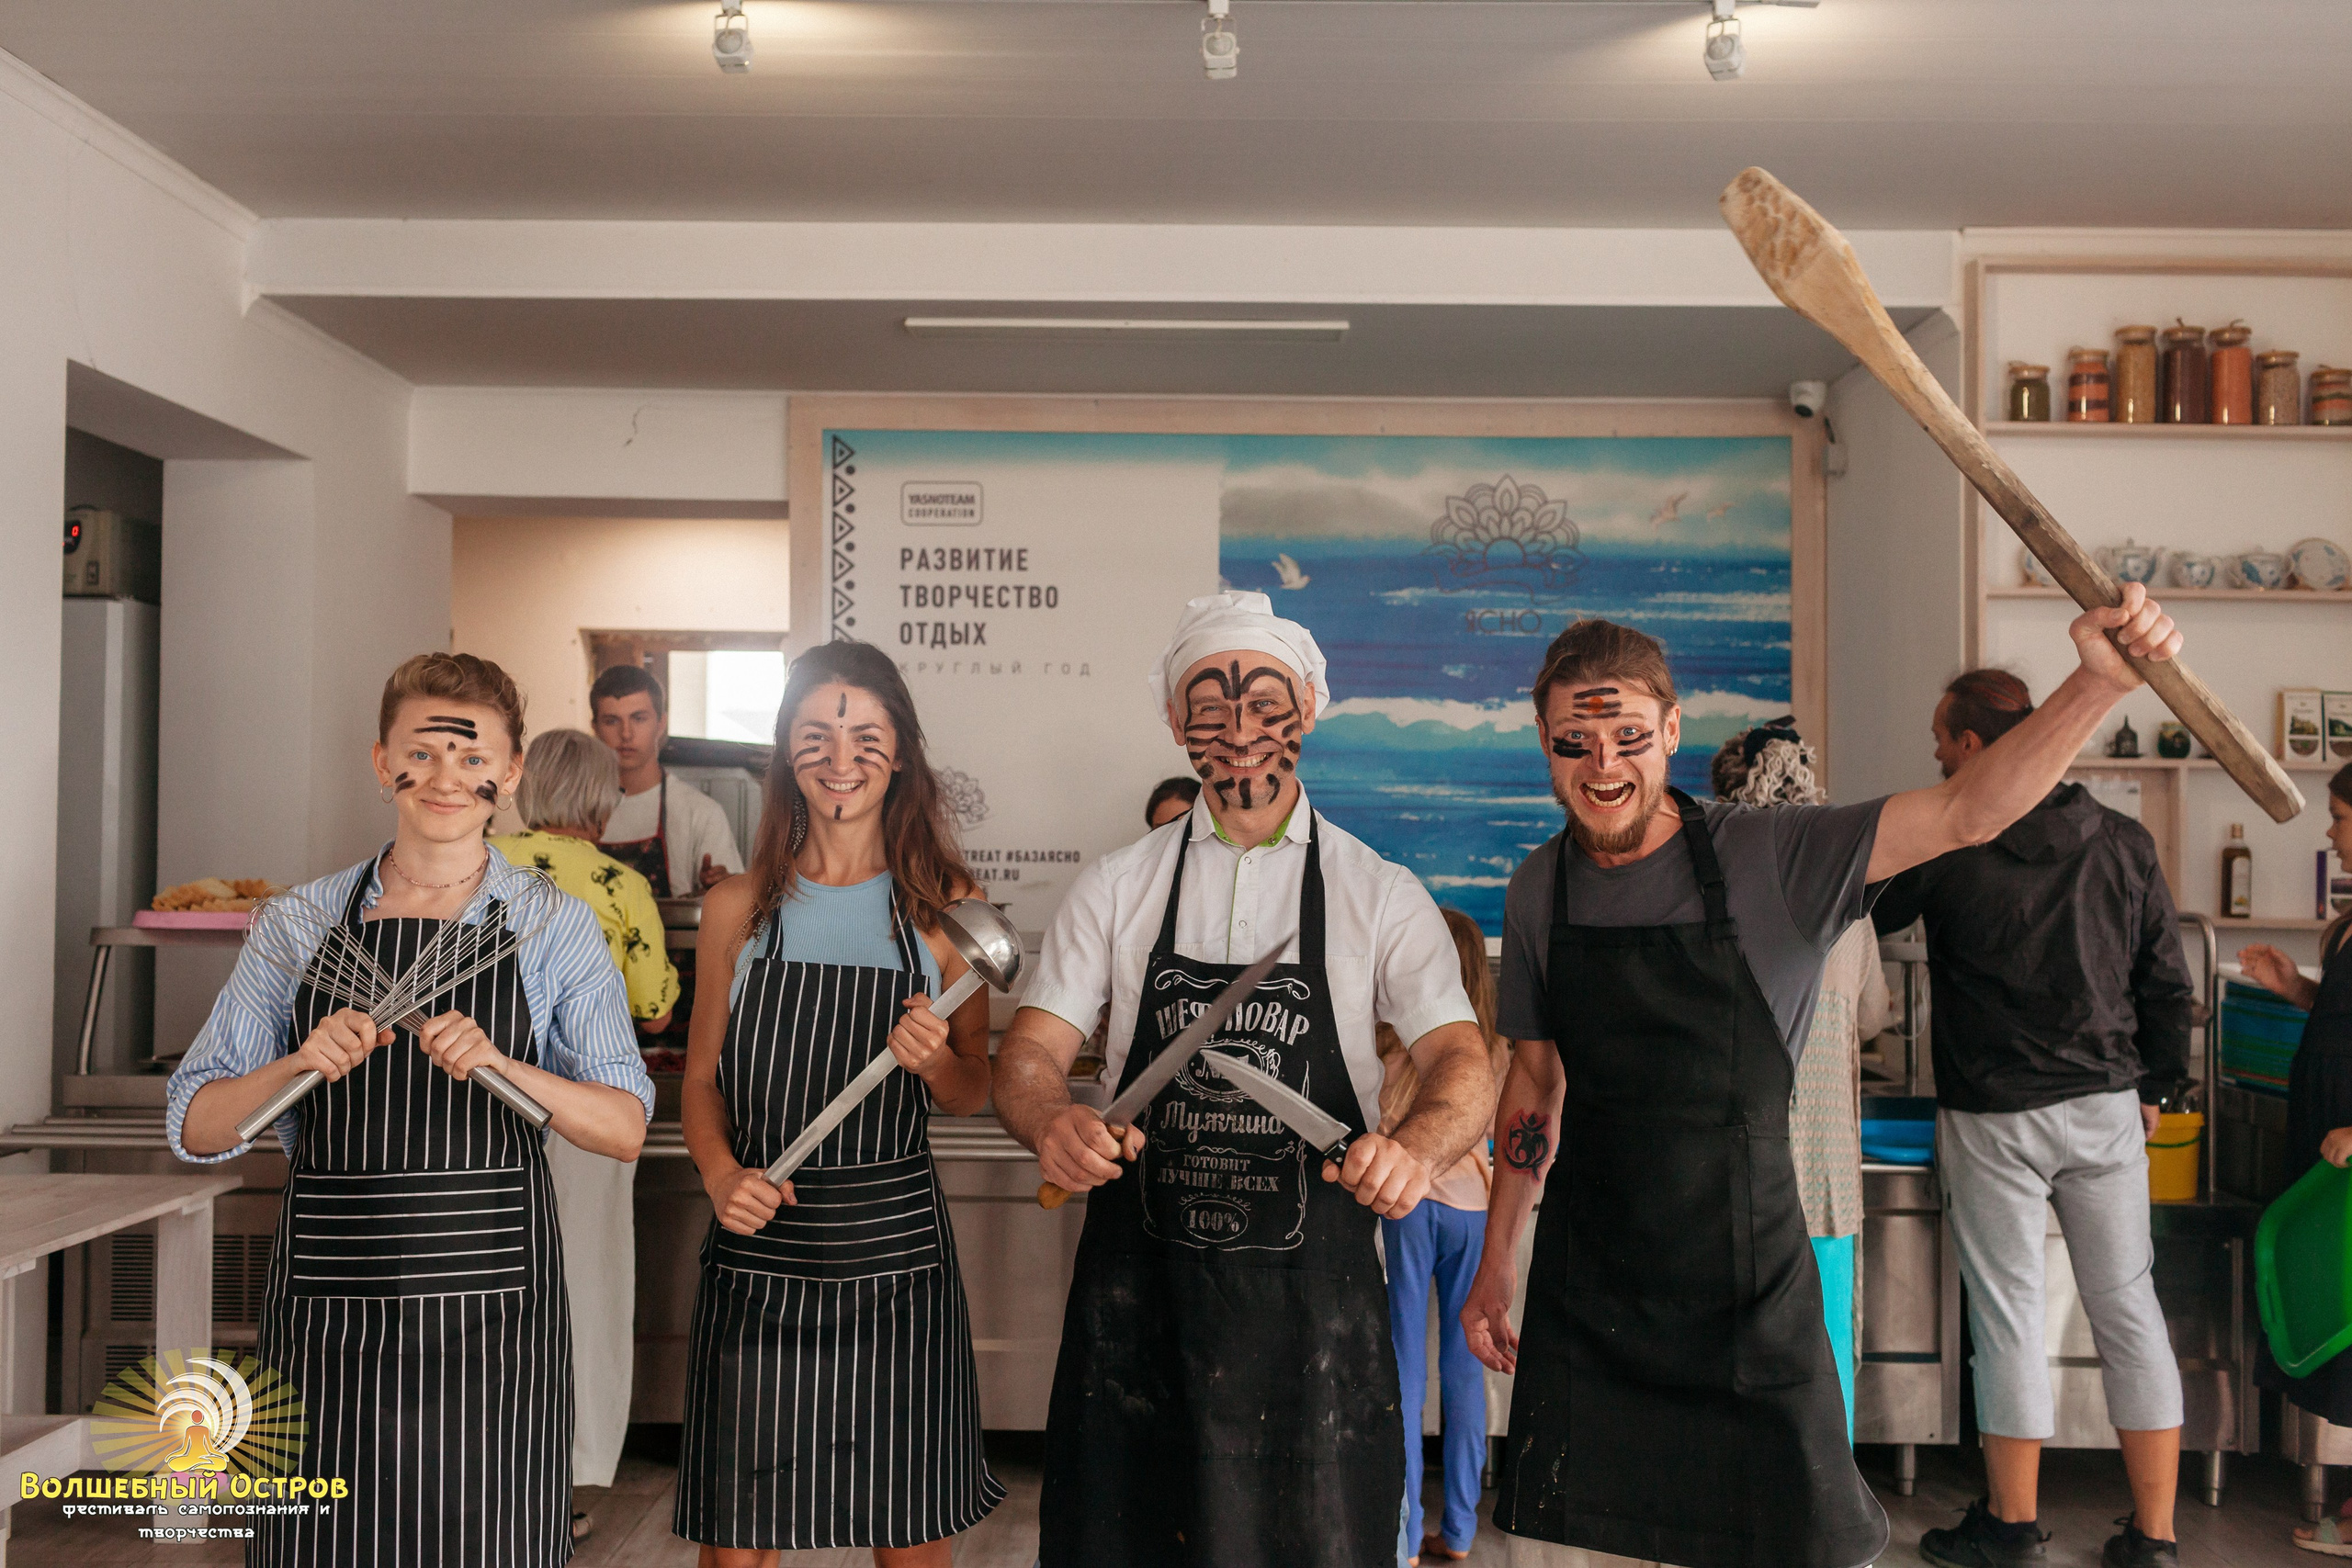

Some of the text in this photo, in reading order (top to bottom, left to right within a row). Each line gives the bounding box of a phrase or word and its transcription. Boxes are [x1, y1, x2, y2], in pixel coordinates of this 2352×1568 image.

[908, 507, 976, 518] COOPERATION
[899, 547, 1029, 571] РАЗВИТИЕ
[899, 584, 1059, 609] ТВОРЧЕСТВО
[899, 621, 988, 649] ОТДЫХ
[899, 660, 1091, 677] КРУГЛЫЙ ГОД
[1160, 1100, 1285, 1144] Мужчина
[1182, 1154, 1251, 1172] ГОТОВИТ
[1157, 1168, 1280, 1192] ЛУЧШЕ ВСЕХ
[1186, 1209, 1240, 1233] 100%
